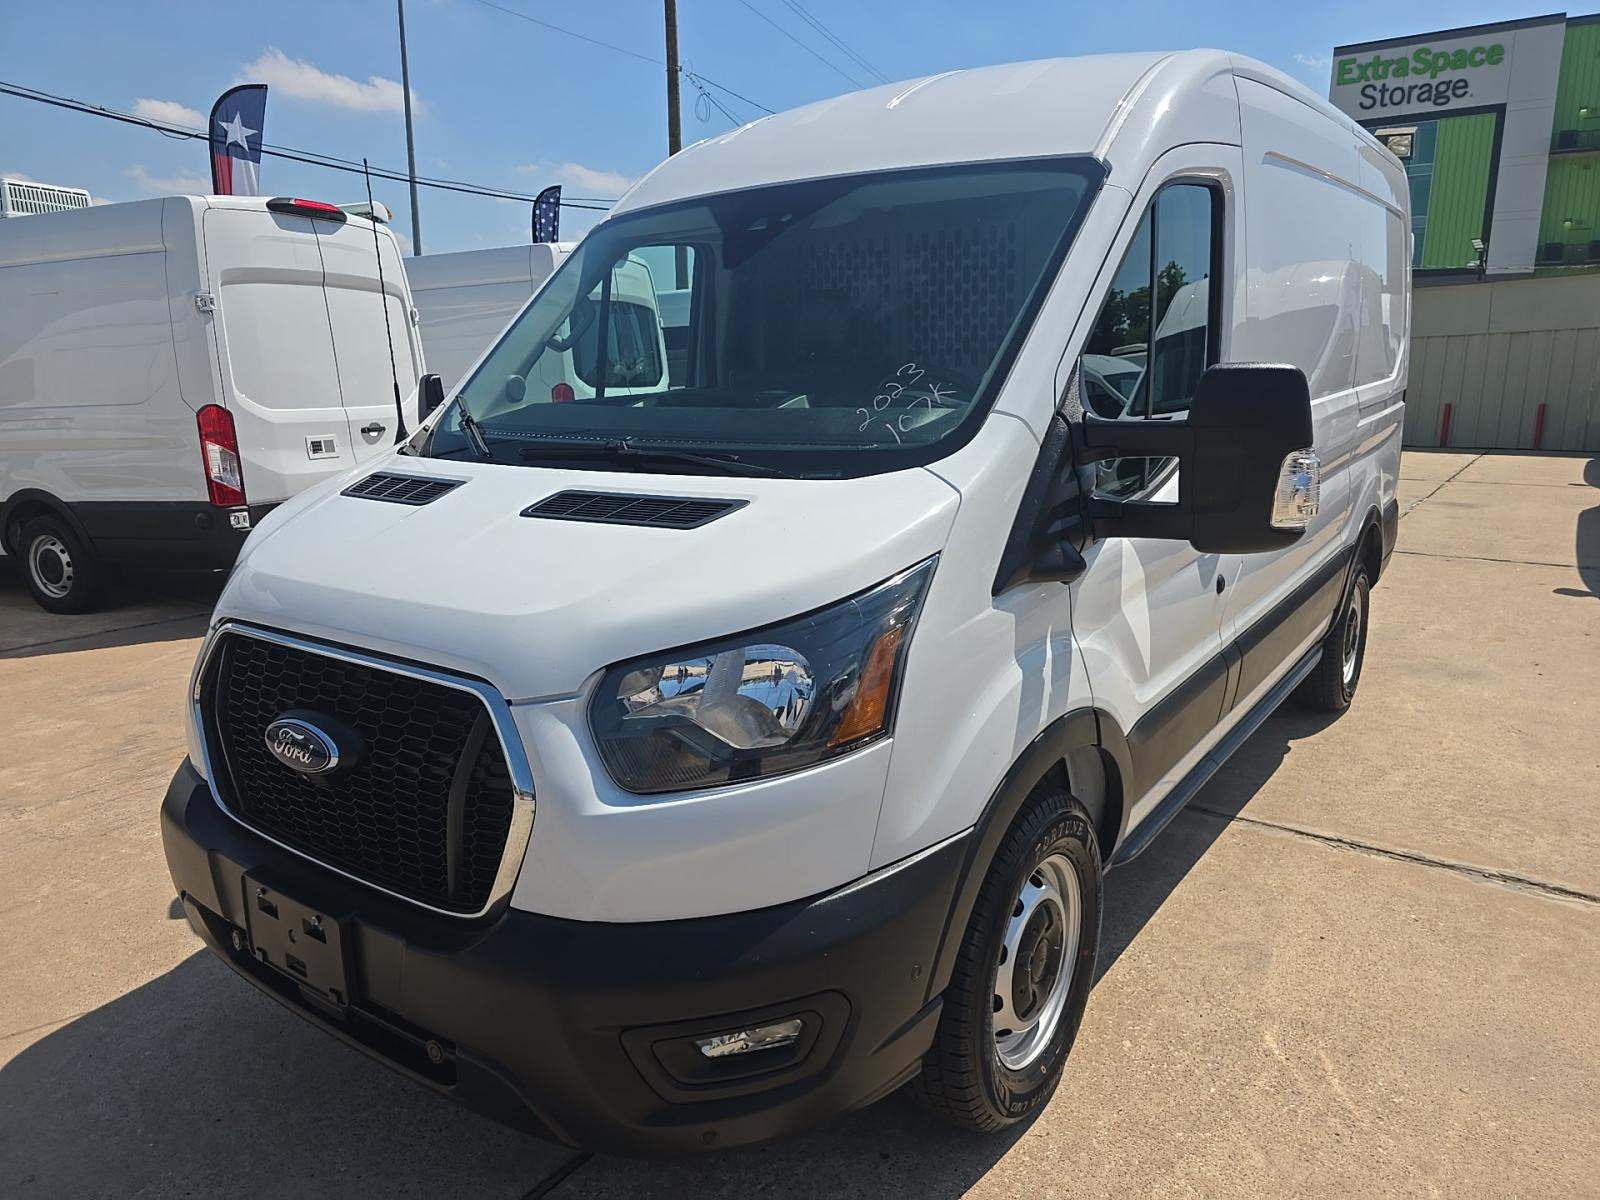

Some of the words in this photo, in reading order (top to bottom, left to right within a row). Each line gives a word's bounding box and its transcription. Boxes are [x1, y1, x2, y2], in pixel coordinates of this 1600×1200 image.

[1358, 77, 1469, 111] Storage
[856, 363, 925, 432] 2023
[274, 728, 314, 764] Ford
